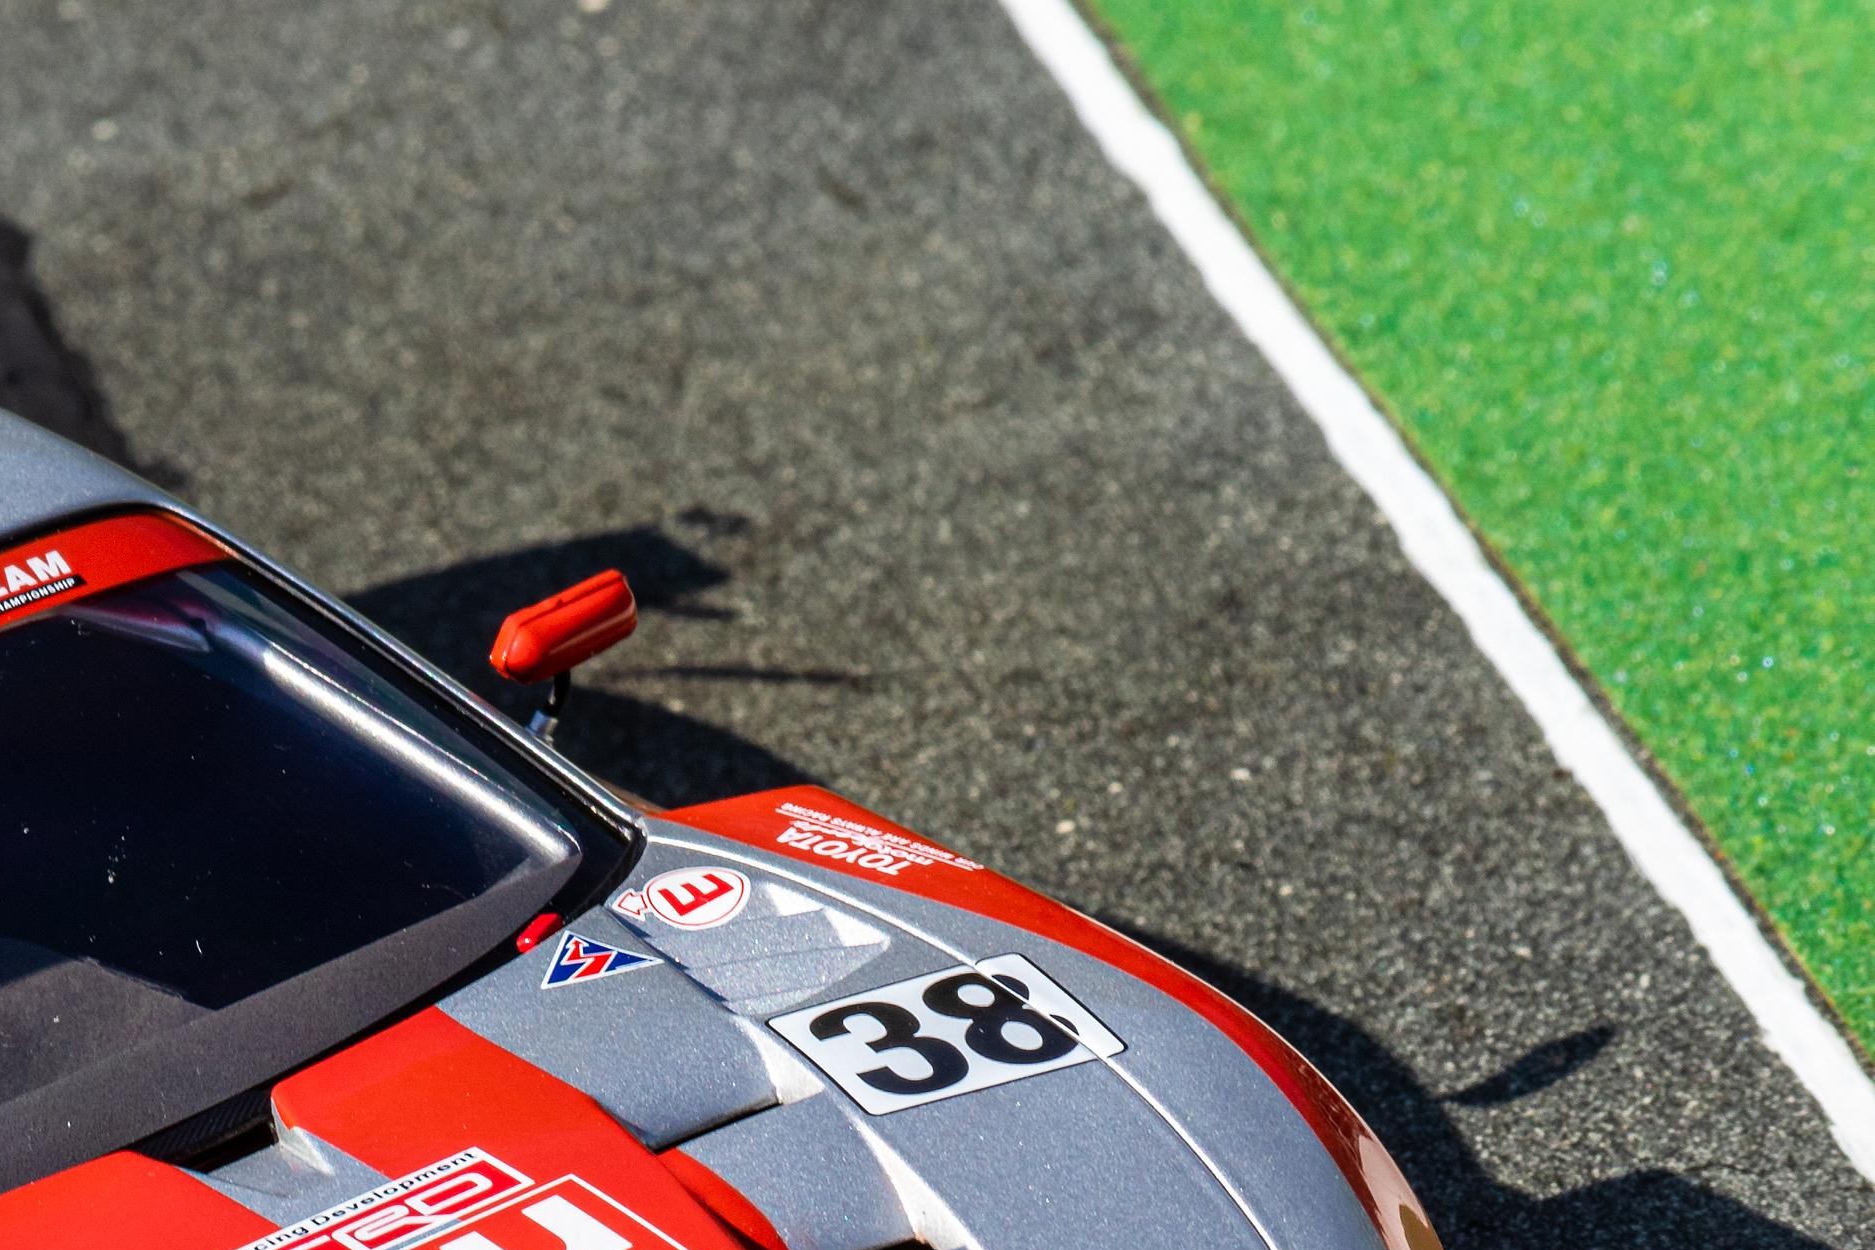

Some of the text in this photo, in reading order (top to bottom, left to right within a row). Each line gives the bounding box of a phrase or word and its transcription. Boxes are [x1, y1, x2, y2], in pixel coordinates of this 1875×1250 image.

[776, 827, 912, 876] TOYOTA
[808, 971, 1081, 1096] 38
[311, 1150, 478, 1228] Development
